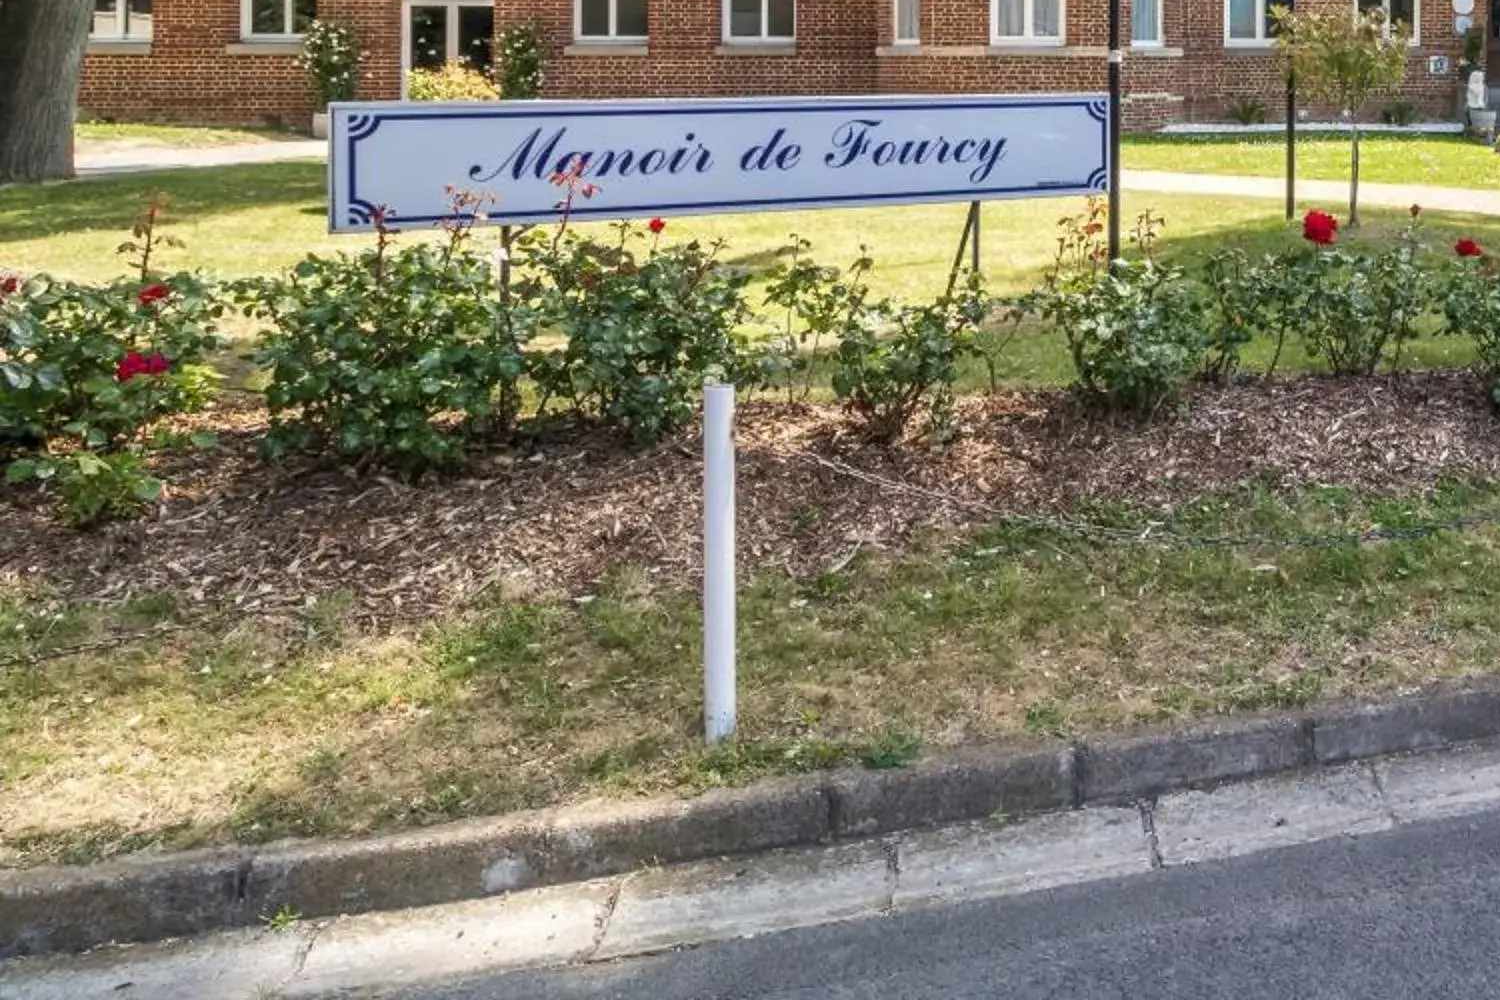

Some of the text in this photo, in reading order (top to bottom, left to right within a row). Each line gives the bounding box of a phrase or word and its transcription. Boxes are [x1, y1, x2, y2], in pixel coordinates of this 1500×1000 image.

[469, 119, 1008, 184] Manoir de Fourcy
